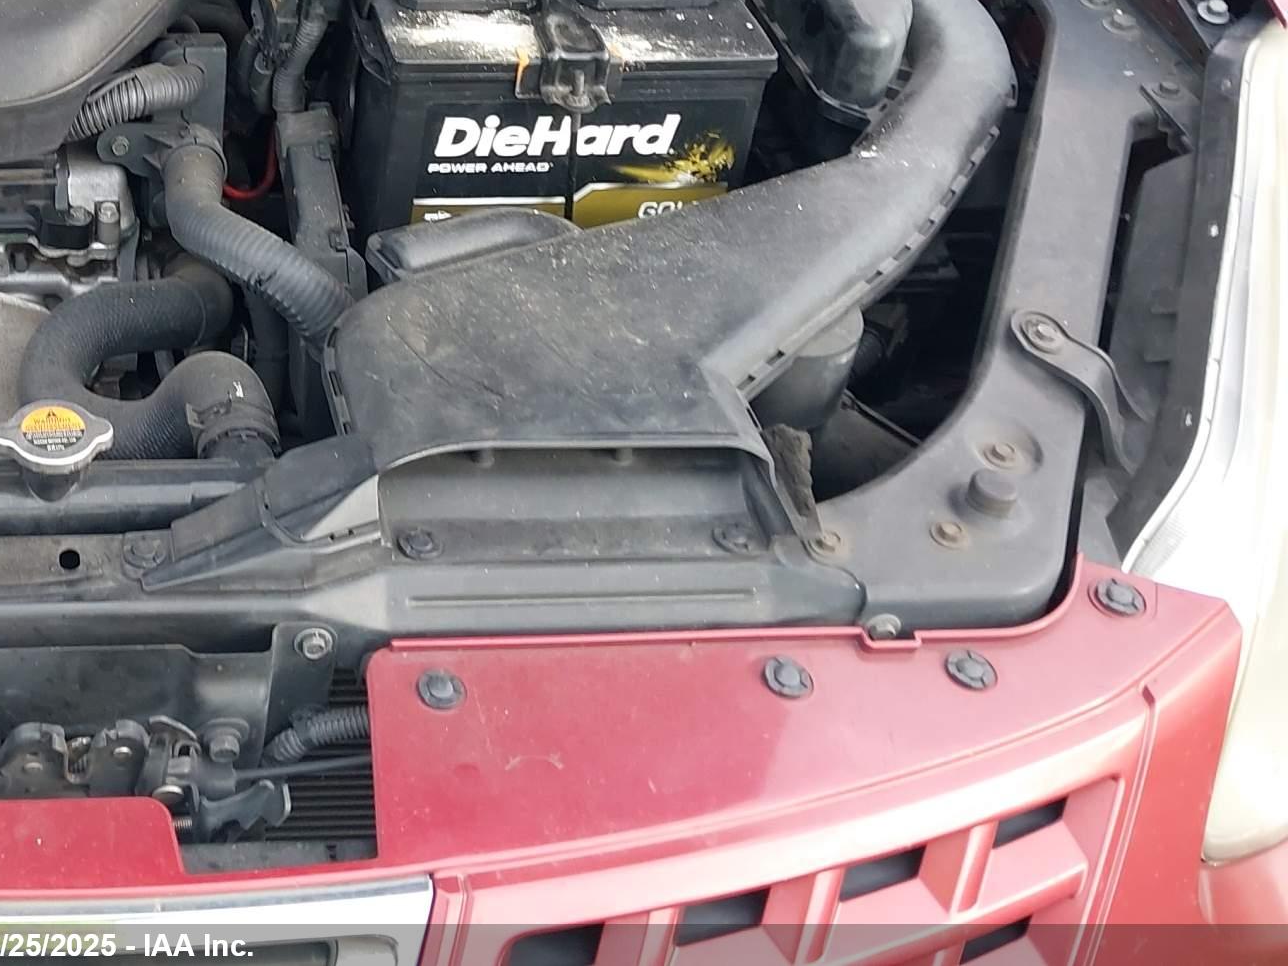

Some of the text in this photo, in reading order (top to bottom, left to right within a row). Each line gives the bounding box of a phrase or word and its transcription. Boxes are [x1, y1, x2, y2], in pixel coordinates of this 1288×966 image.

[435, 114, 682, 158] DieHard
[427, 161, 551, 174] POWER AHEAD
